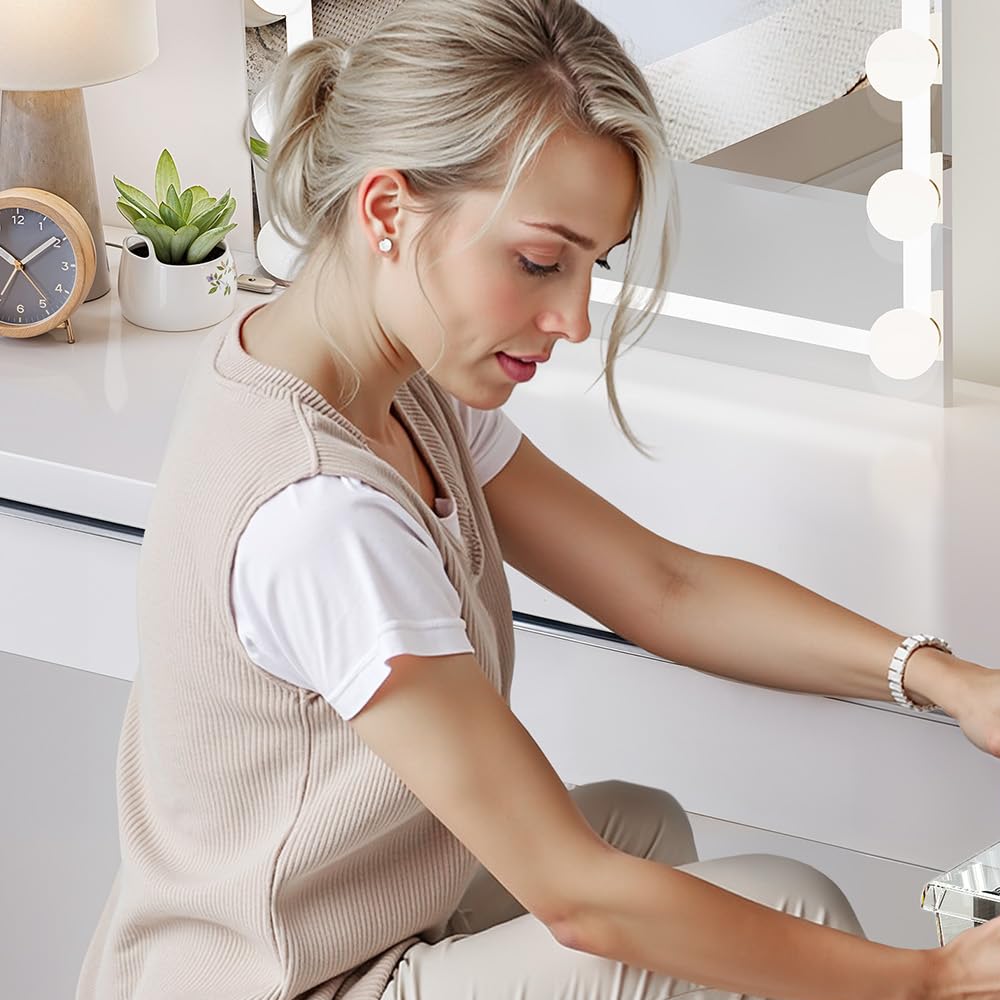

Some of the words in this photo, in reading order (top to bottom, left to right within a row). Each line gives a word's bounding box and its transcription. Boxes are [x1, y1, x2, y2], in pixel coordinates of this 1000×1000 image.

[11, 215, 25, 225] 12
[38, 222, 43, 231] 1
[53, 238, 61, 248] 2
[61, 261, 69, 271] 3
[55, 283, 63, 293] 4
[16, 304, 25, 313] 6
[39, 299, 47, 308] 5
